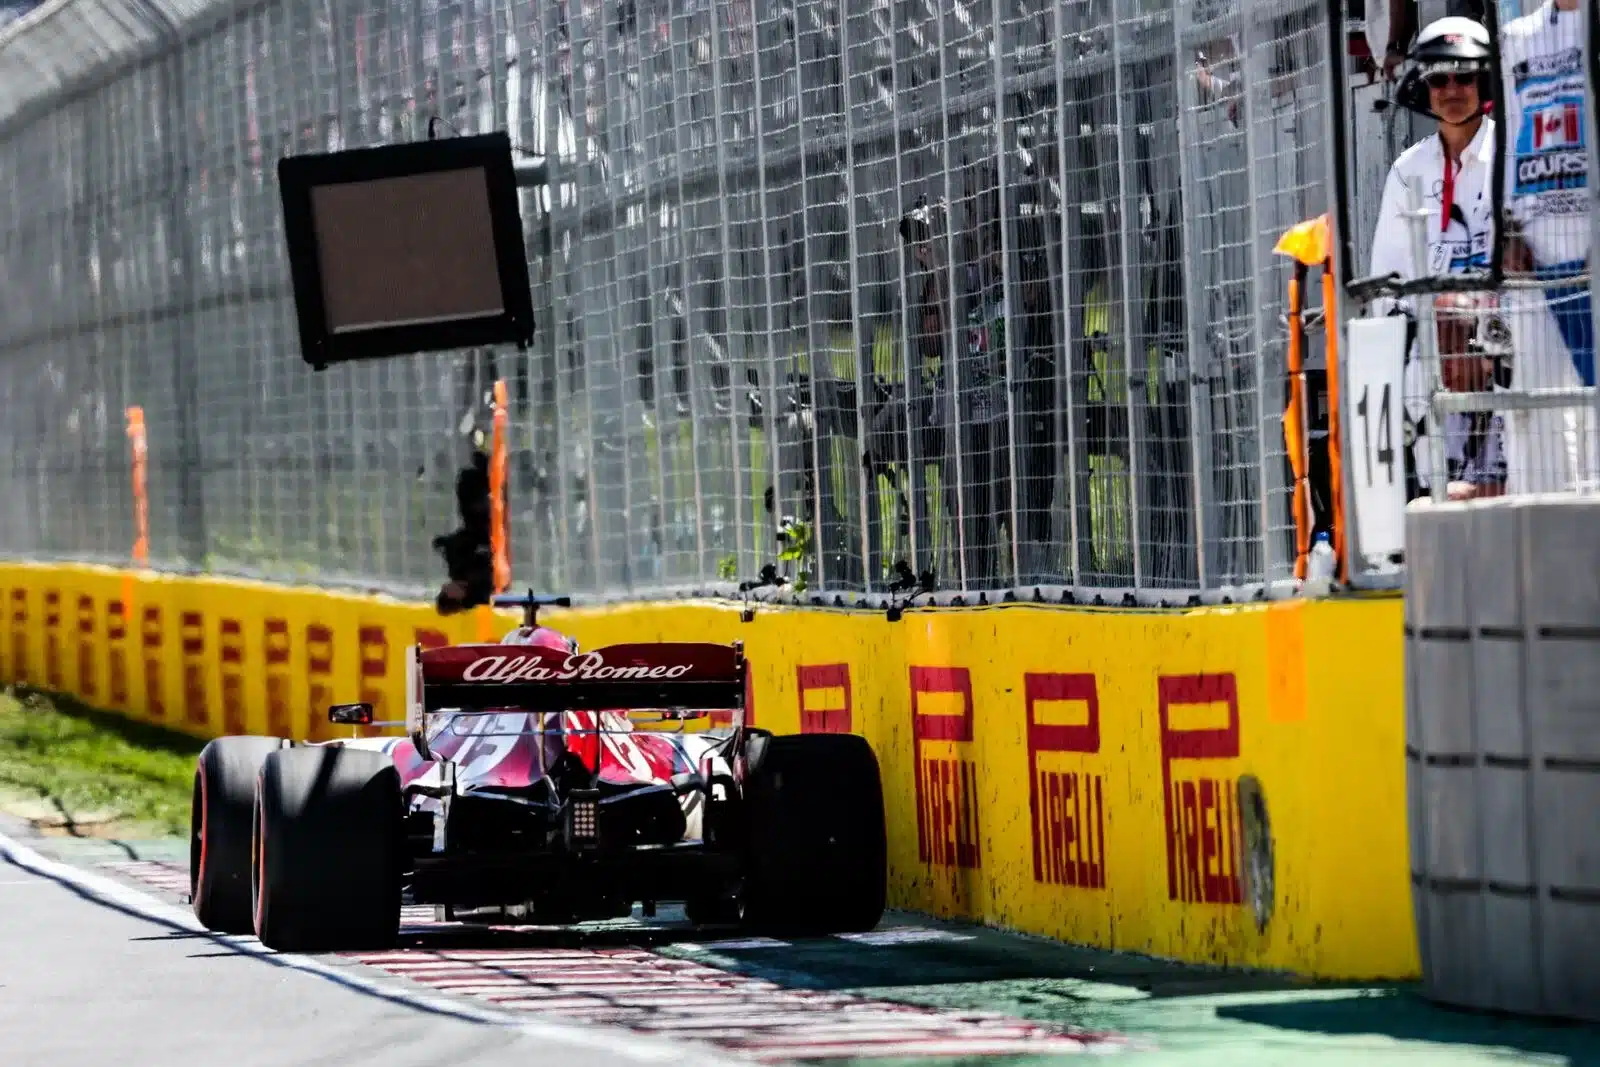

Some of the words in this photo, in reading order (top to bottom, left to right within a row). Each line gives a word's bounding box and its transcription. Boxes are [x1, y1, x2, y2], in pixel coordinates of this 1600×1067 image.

[1358, 383, 1394, 487] 14
[462, 656, 551, 684] Alfa
[559, 651, 693, 680] Romeo
[909, 665, 981, 868] PIRELLI
[1024, 672, 1105, 889] PIRELLI
